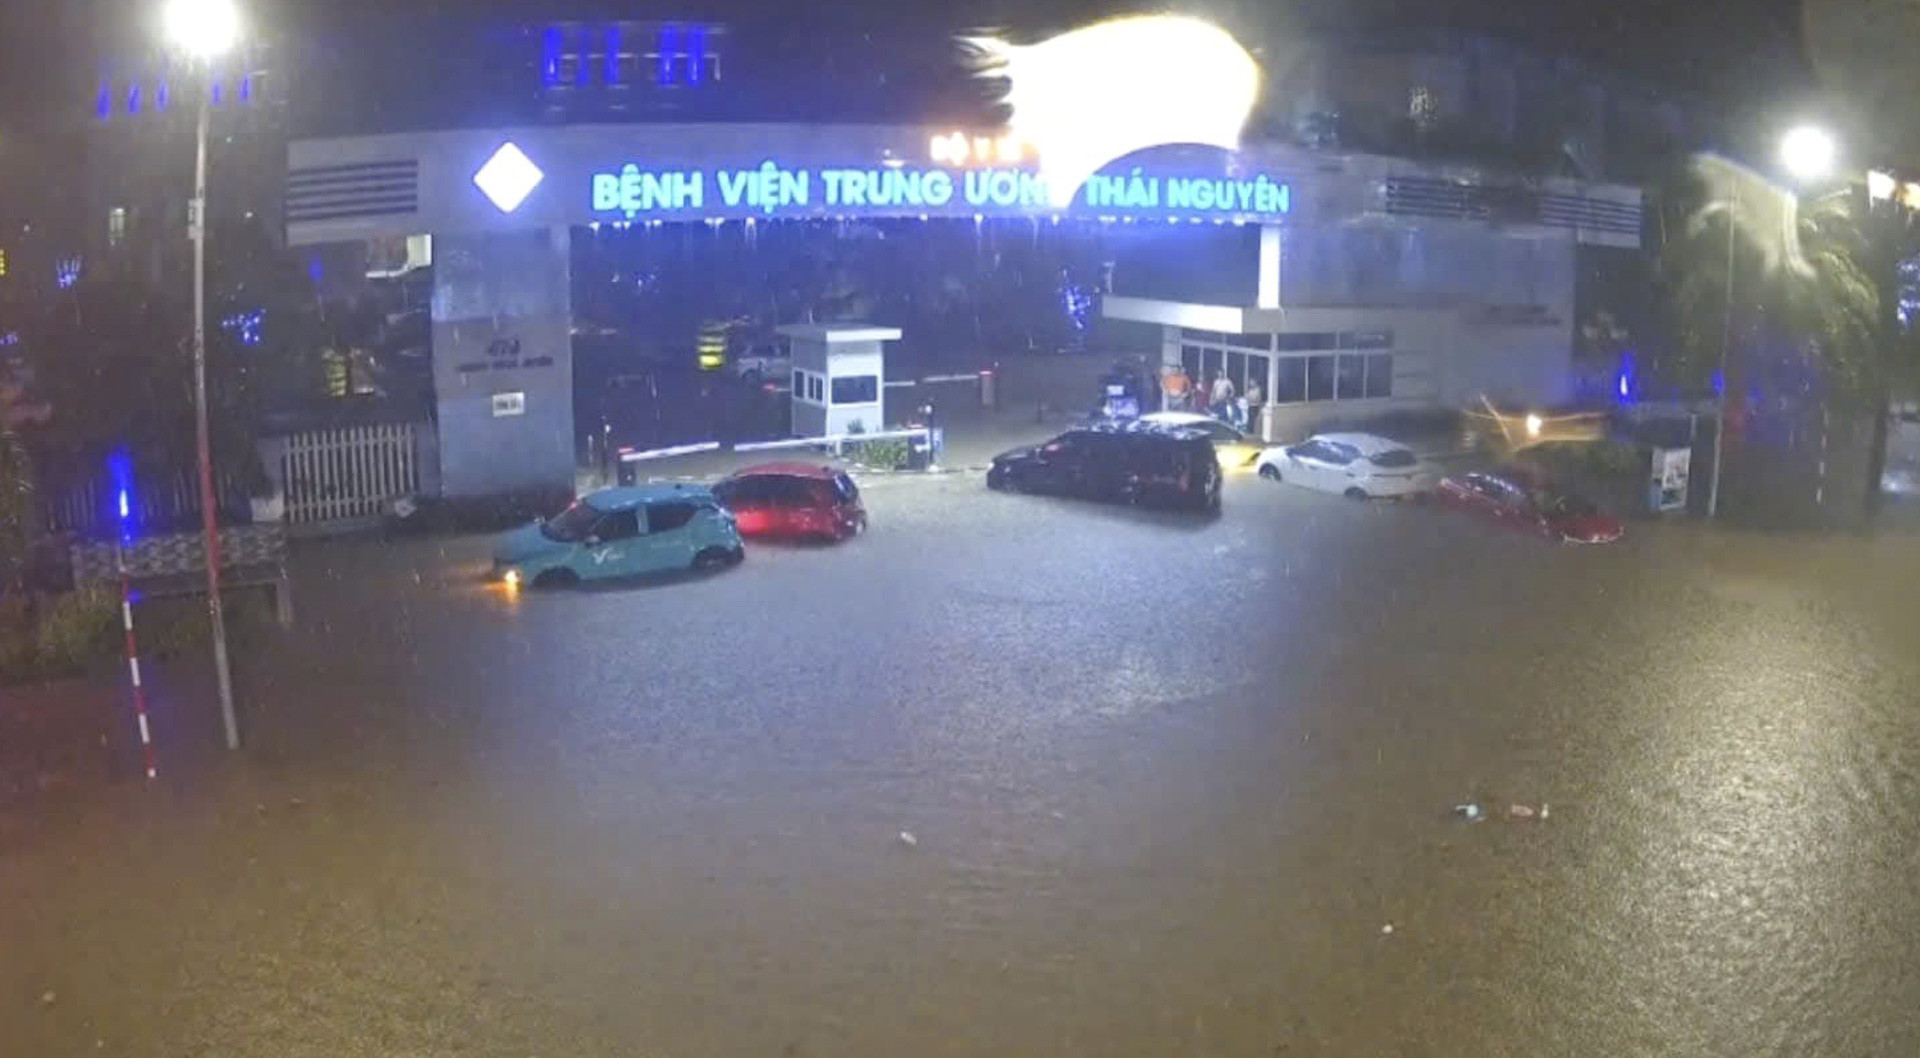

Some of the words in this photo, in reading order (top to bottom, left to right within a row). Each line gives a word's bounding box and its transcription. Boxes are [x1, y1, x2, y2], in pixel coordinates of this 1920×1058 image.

[593, 163, 703, 218] BỆNH
[717, 160, 809, 214] VIỆN
[821, 167, 953, 206] TRUNG
[964, 167, 1052, 206] ƯƠN
[1087, 166, 1159, 207] THÁI
[1168, 174, 1290, 213] NGUYÊN
